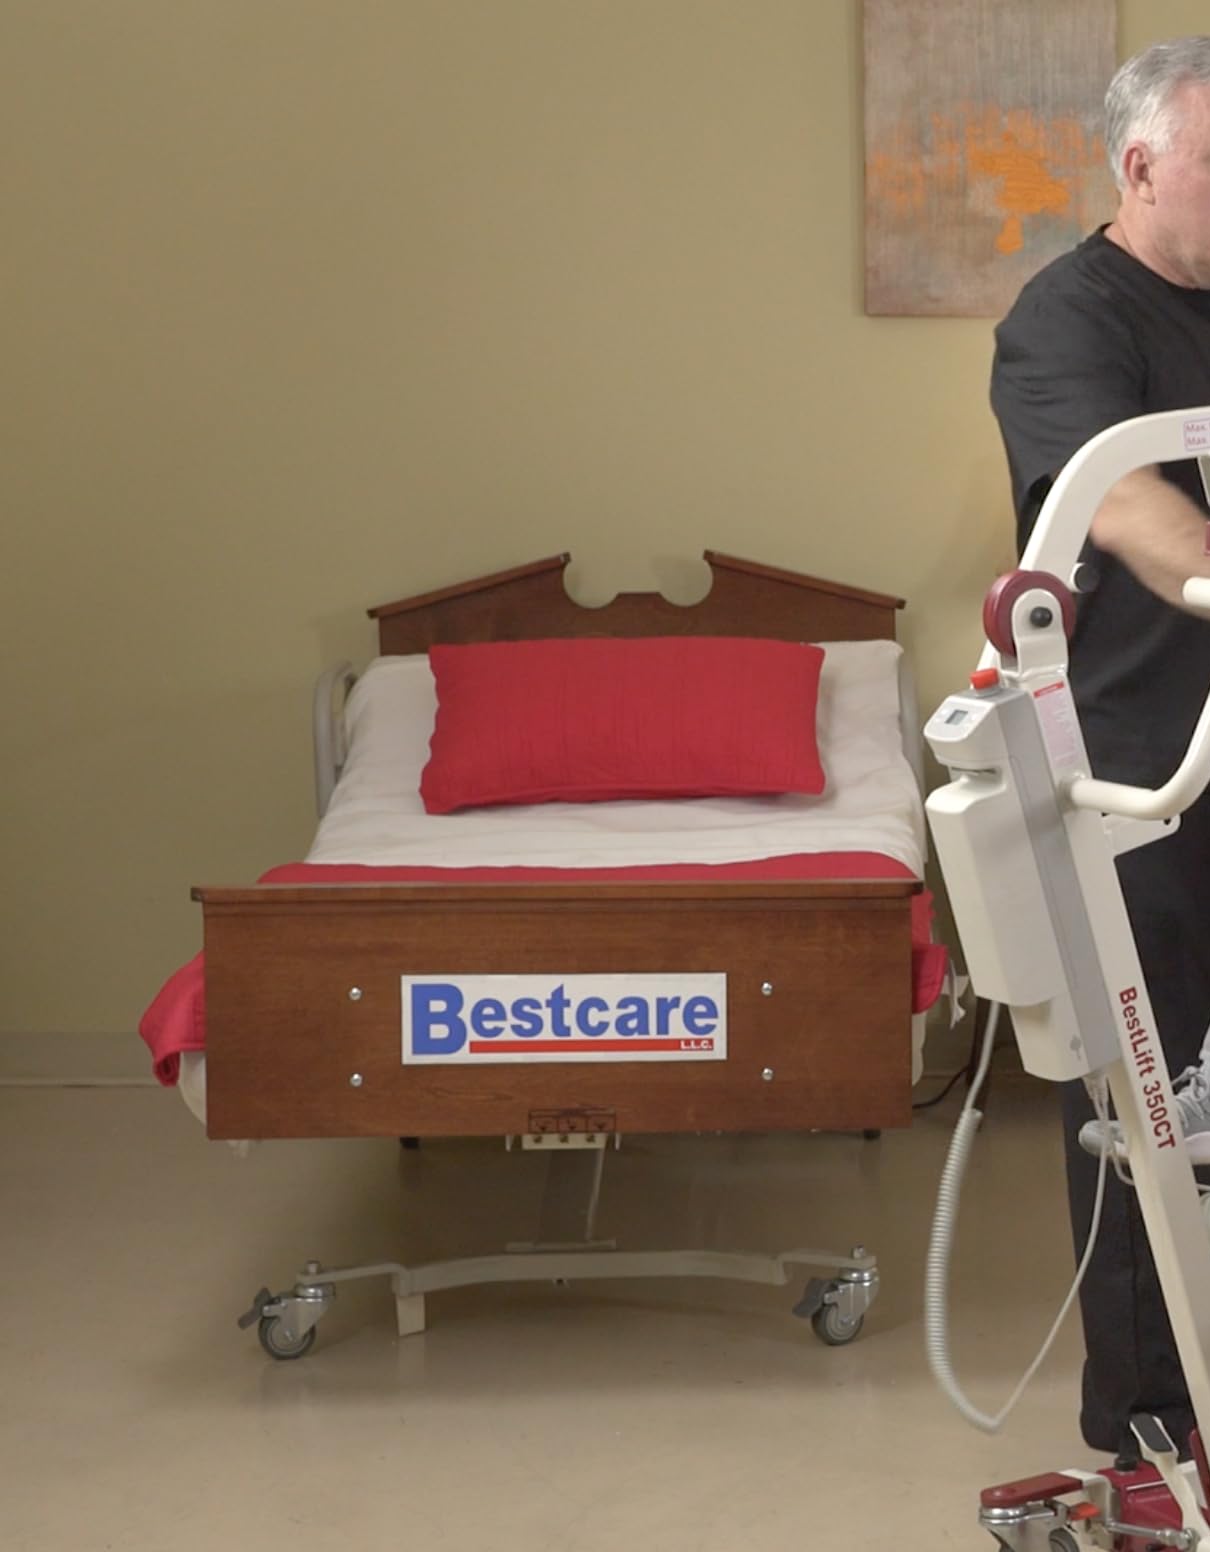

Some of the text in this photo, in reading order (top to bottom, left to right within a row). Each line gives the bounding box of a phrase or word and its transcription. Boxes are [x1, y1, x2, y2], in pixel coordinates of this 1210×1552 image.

[411, 983, 718, 1056] Bestcare
[680, 1039, 713, 1050] L.L.C.
[1119, 986, 1176, 1150] BestLift 350CT
